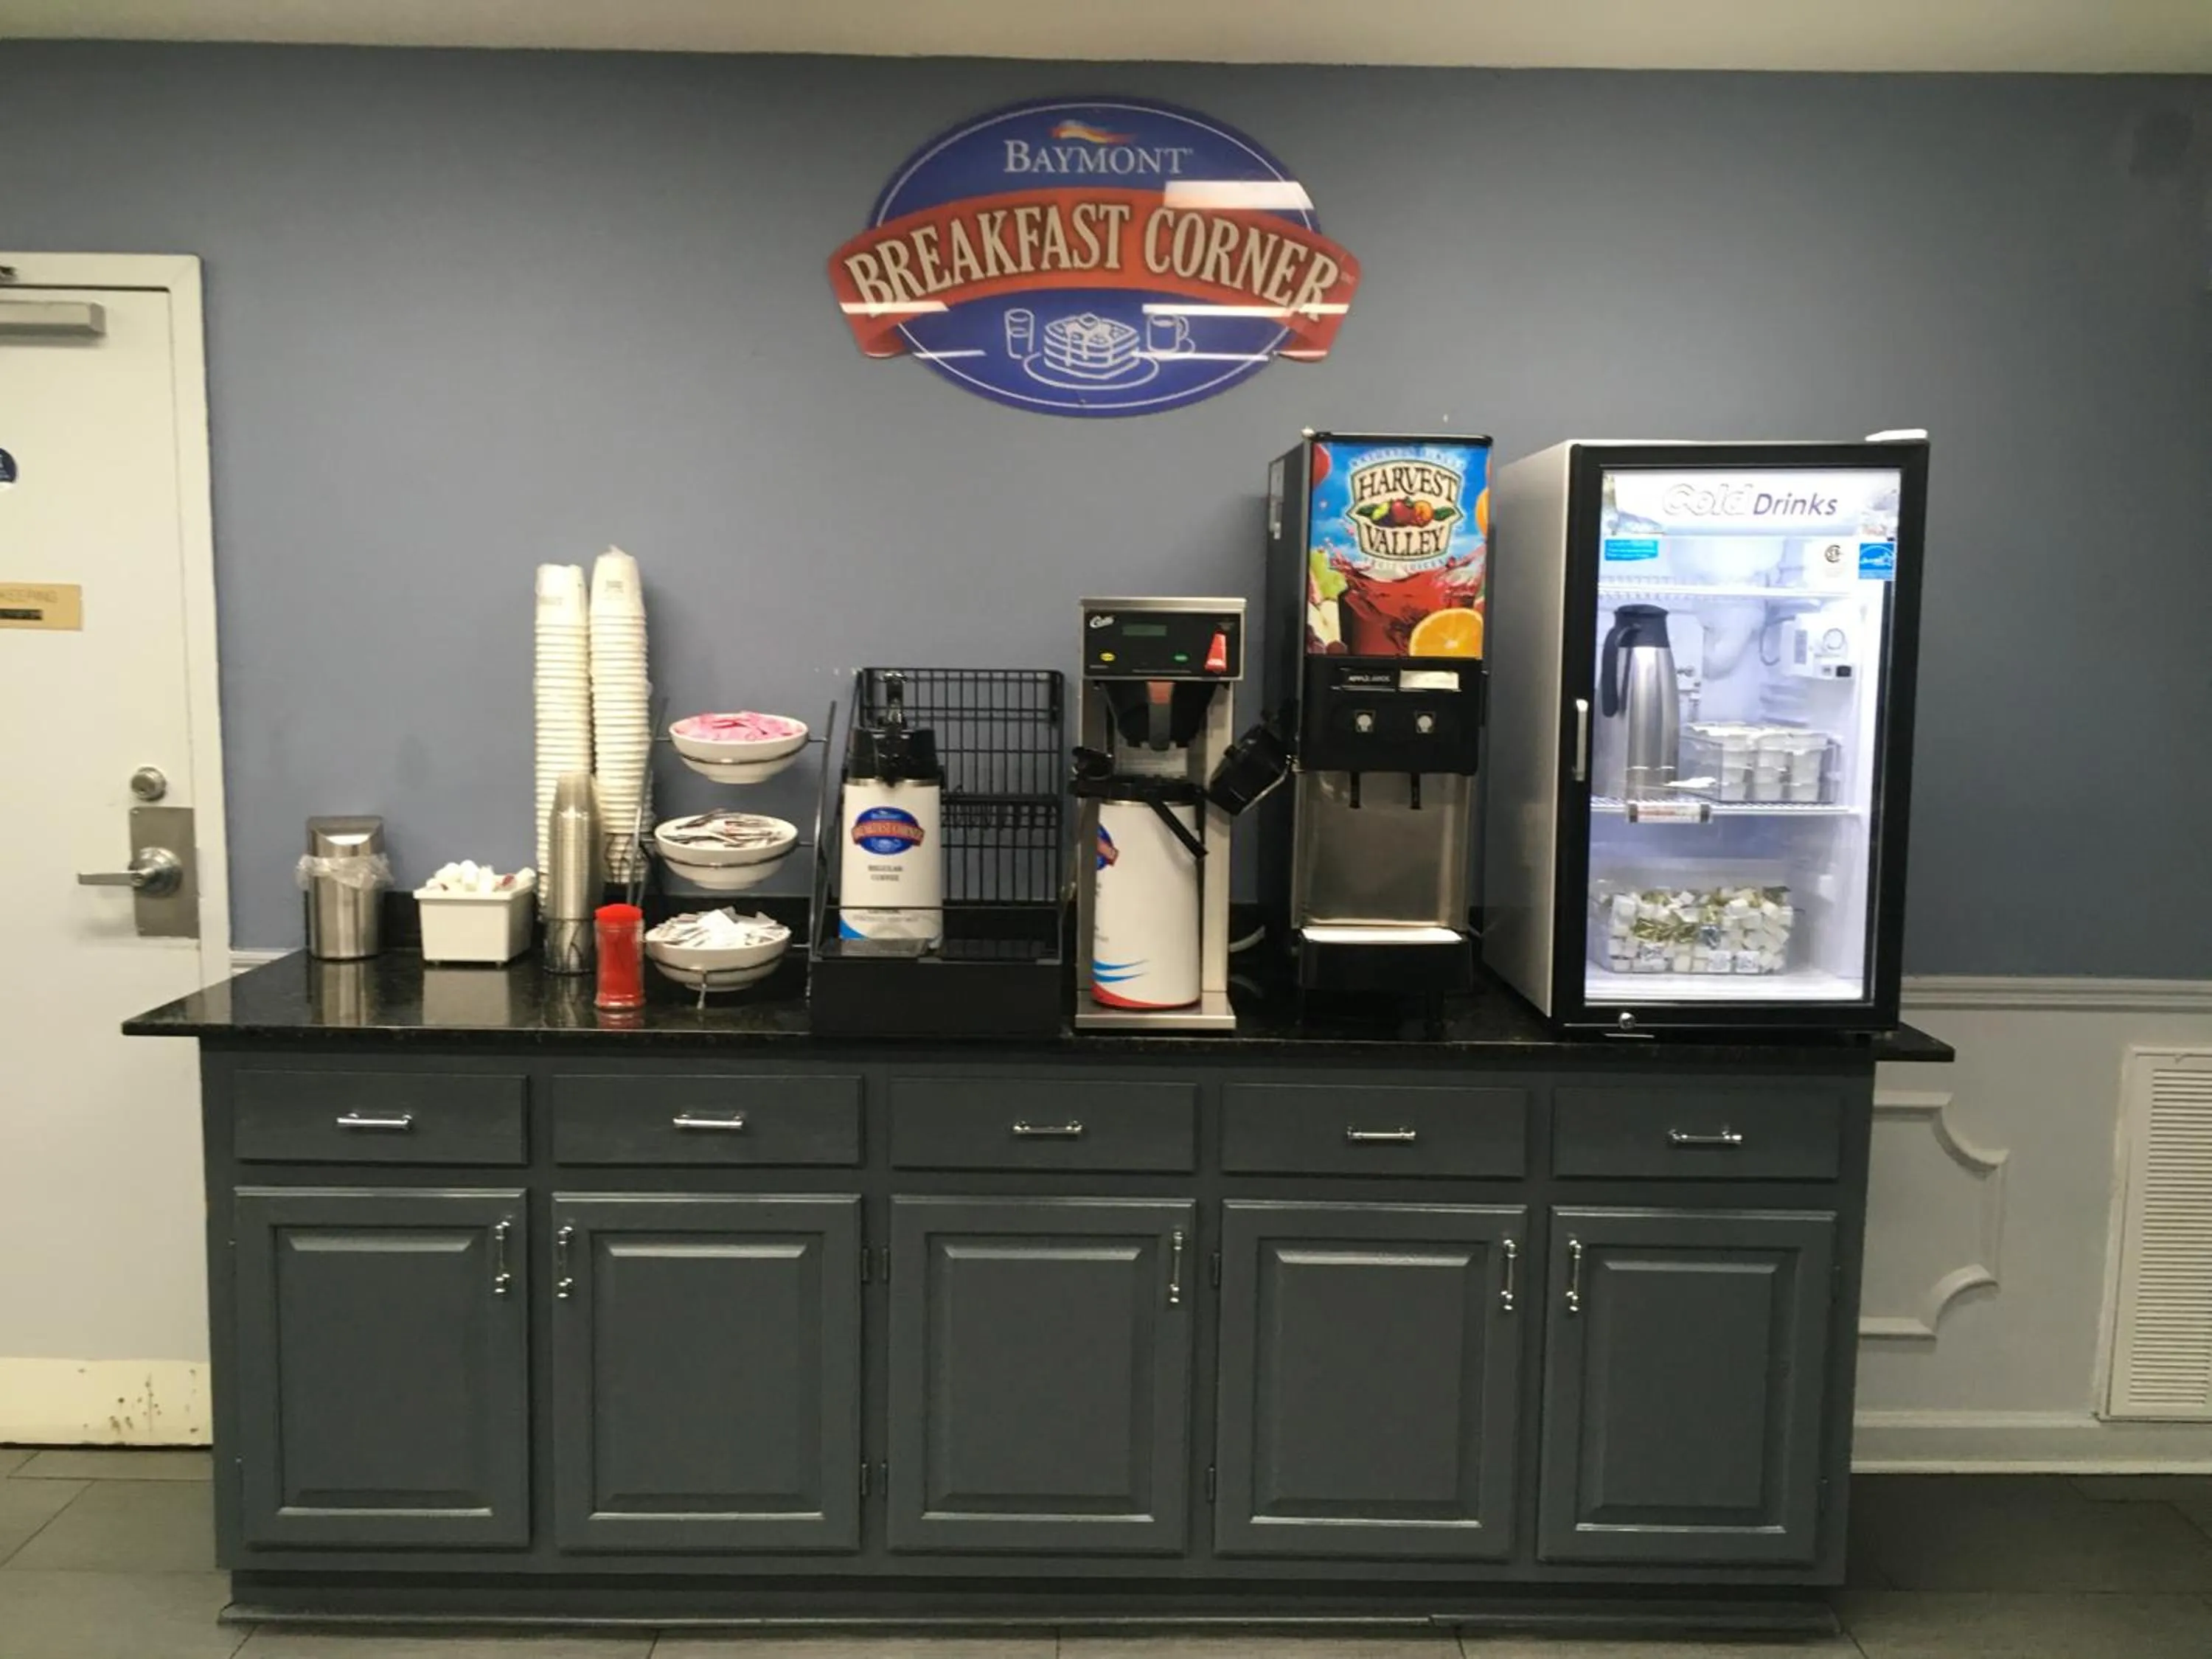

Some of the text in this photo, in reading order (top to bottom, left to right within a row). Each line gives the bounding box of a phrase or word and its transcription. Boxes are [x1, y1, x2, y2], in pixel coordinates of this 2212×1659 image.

[1003, 139, 1186, 175] BAYMONT
[845, 202, 1340, 322] BREAKFAST CORNER
[1357, 466, 1458, 503] HARVEST
[1661, 483, 1838, 516] Cold Drinks
[1364, 523, 1446, 556] VALLEY
